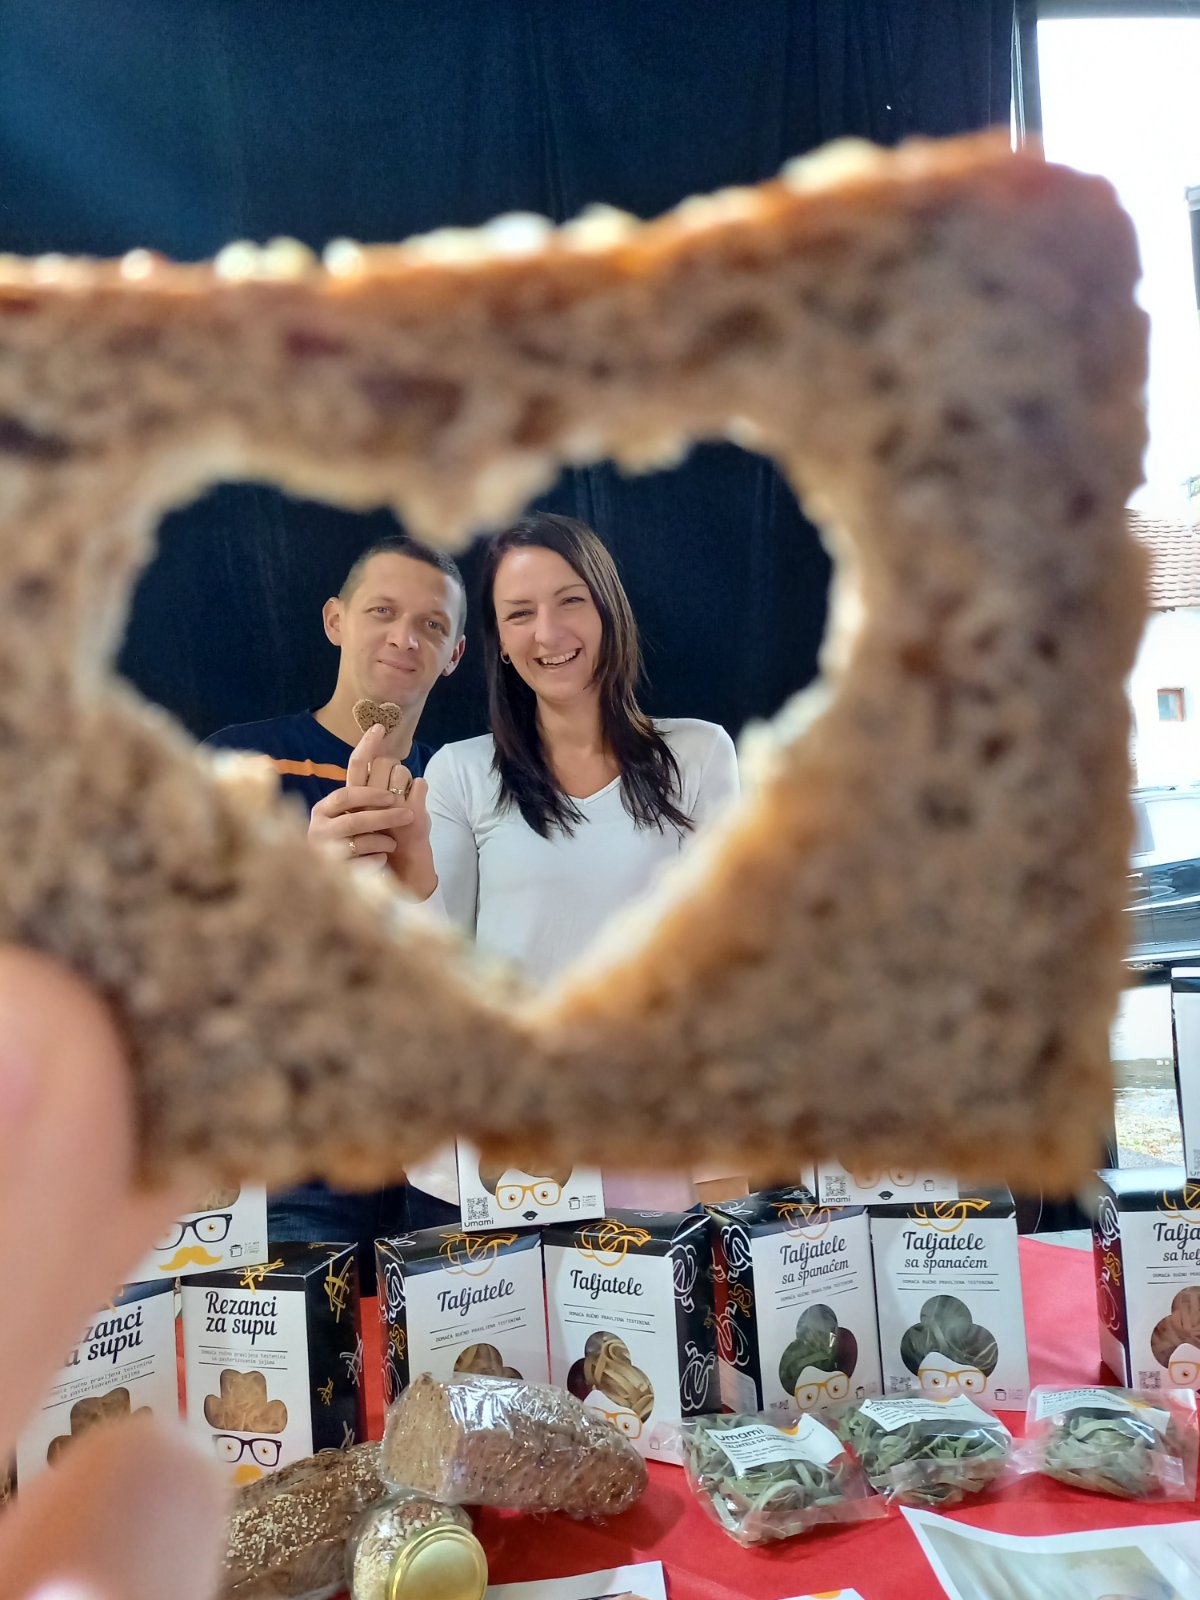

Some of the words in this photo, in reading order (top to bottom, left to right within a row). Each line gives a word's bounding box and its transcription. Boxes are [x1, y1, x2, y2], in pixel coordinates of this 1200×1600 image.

[780, 1235, 847, 1270] Taljatele
[902, 1231, 986, 1259] Taljatele
[1163, 1252, 1178, 1261] sa
[904, 1259, 920, 1268] sa
[570, 1269, 644, 1300] Taljatele
[782, 1273, 795, 1285] sa
[205, 1291, 278, 1317] Rezanci
[437, 1279, 516, 1317] Taljatele
[79, 1306, 144, 1343] zanci
[206, 1317, 227, 1333] za
[231, 1318, 278, 1345] supu
[87, 1330, 143, 1364] supu
